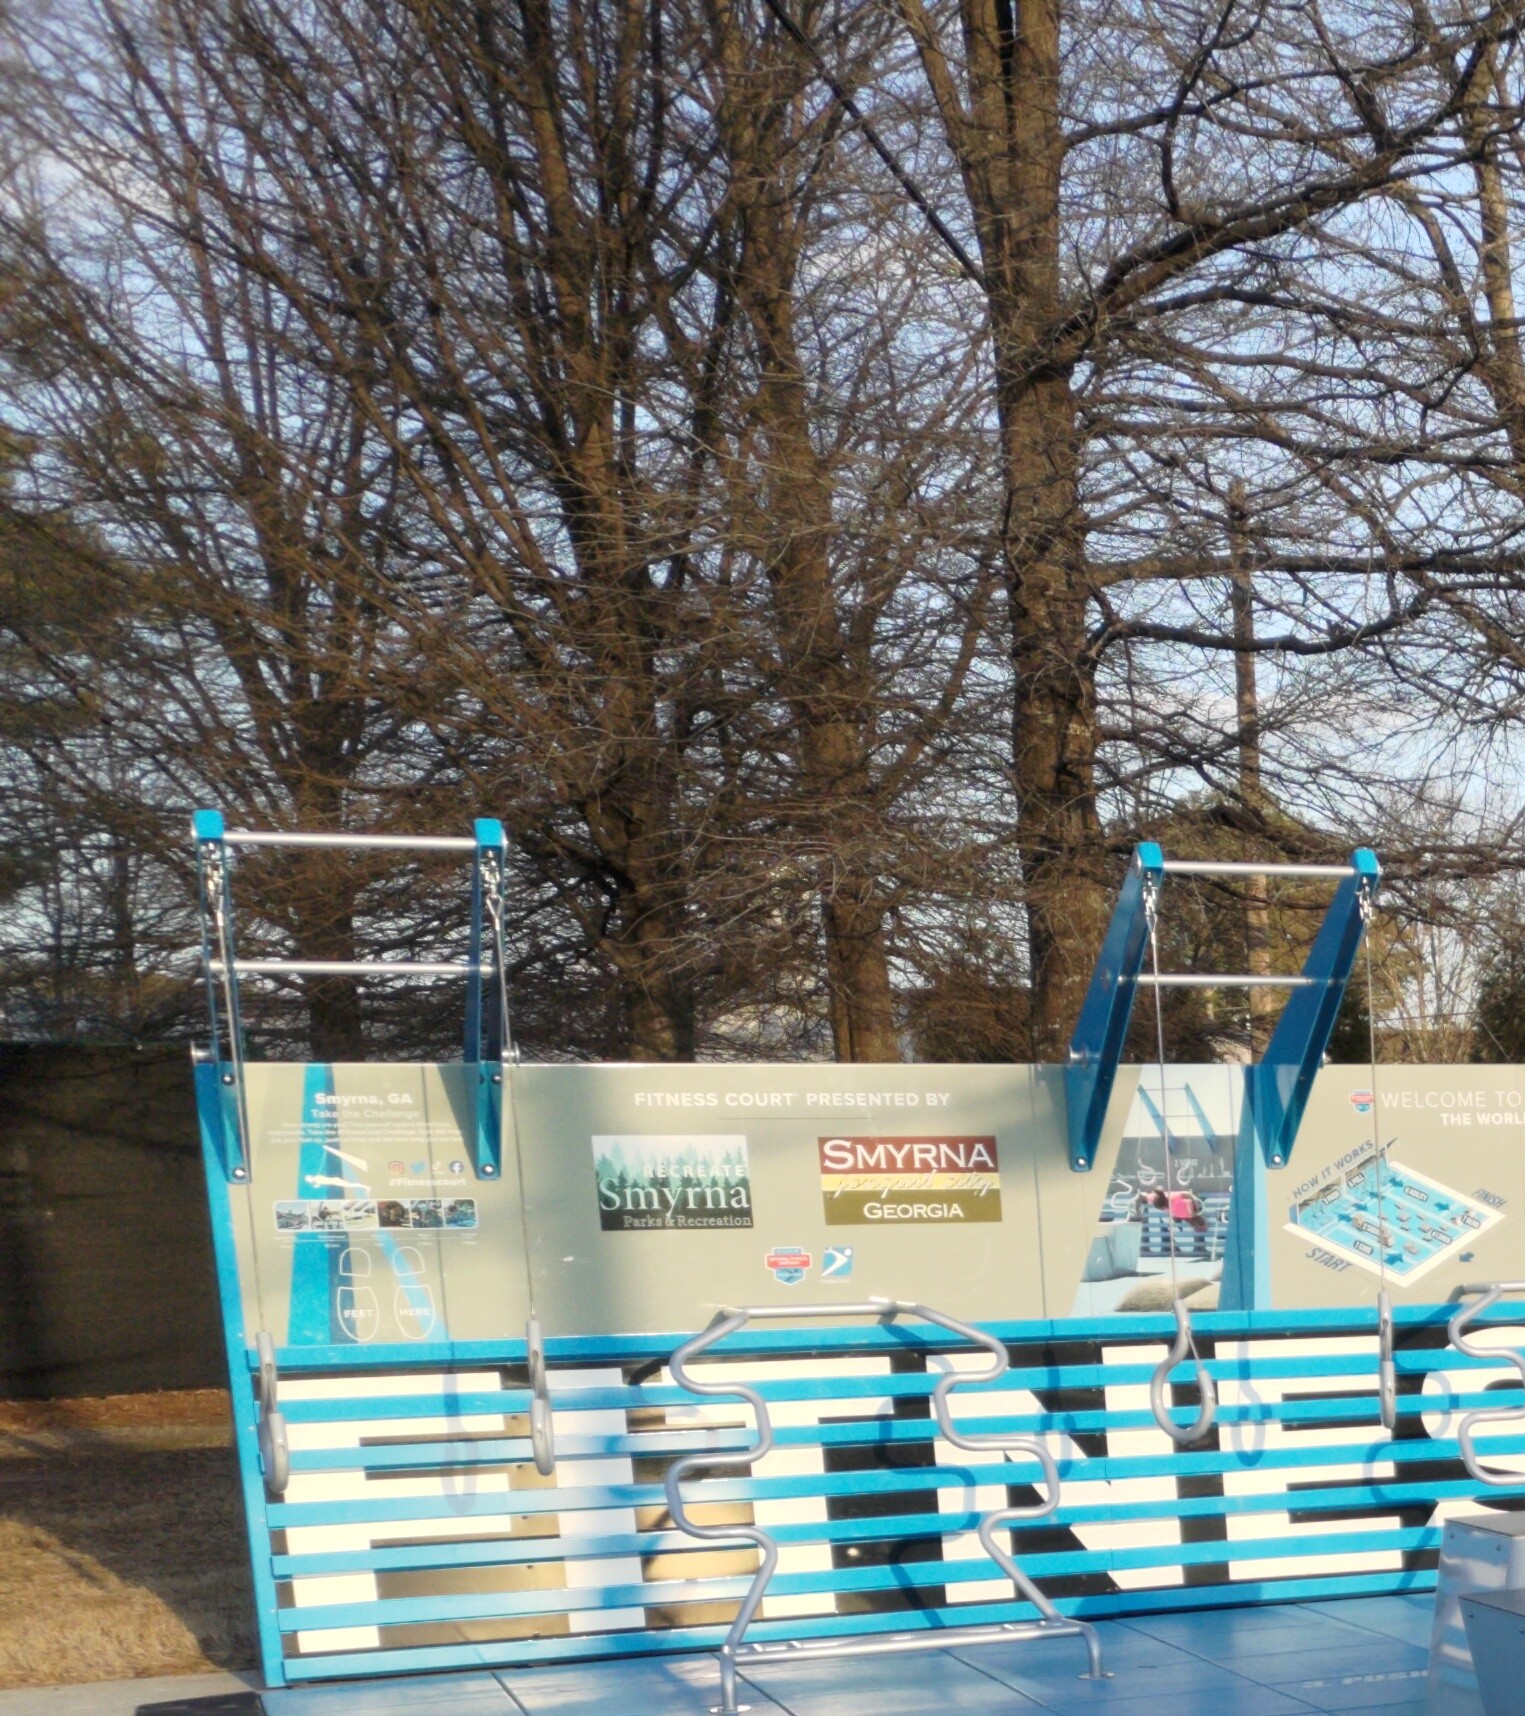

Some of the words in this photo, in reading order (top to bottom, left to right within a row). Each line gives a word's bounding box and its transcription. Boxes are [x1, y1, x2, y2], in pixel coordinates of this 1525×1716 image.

[315, 1093, 383, 1106] Smyrna,
[387, 1093, 413, 1104] GA
[635, 1092, 718, 1106] FITNESS
[807, 1092, 918, 1106] PRESENTED
[926, 1092, 950, 1106] BY
[1381, 1091, 1487, 1108] WELCOME
[1494, 1091, 1522, 1107] TO
[311, 1109, 338, 1118] Take
[341, 1109, 360, 1118] the
[363, 1109, 420, 1120] Challenge
[1440, 1113, 1471, 1125] THE
[823, 1139, 995, 1170] SMYRNA
[643, 1164, 746, 1178] RECREATE
[1292, 1176, 1320, 1198] HOW
[1321, 1167, 1331, 1179] IT
[1333, 1140, 1374, 1171] WORKS
[599, 1178, 750, 1218] Smyrna
[863, 1202, 965, 1219] GEORGIA
[623, 1215, 662, 1228] Parks
[677, 1214, 752, 1227] Recreation
[1305, 1247, 1353, 1271] START
[344, 1309, 373, 1318] FEET
[400, 1307, 430, 1316] HERE
